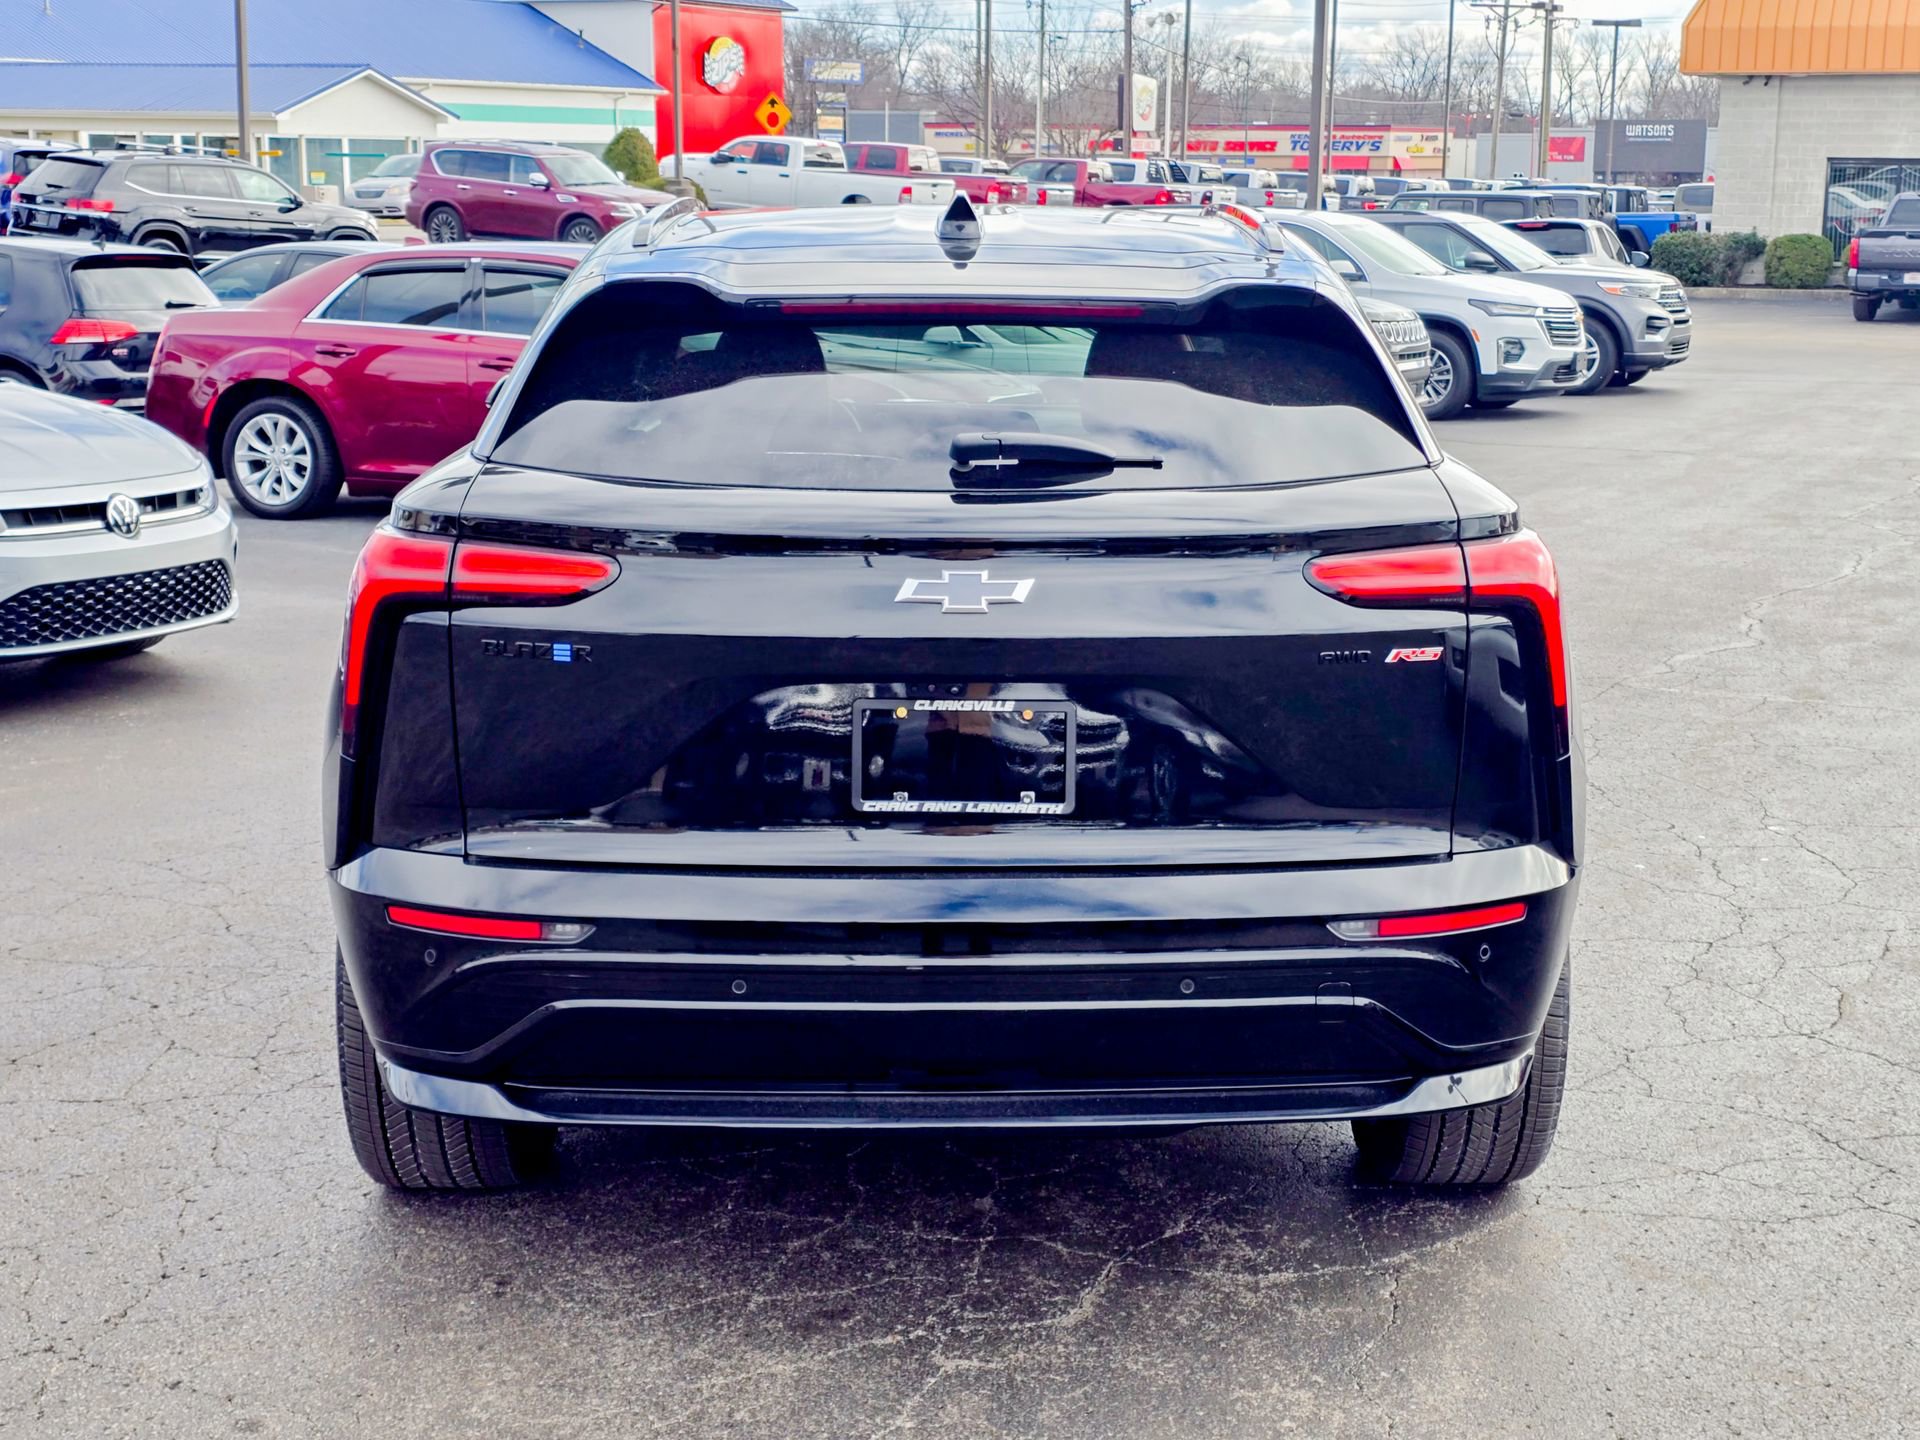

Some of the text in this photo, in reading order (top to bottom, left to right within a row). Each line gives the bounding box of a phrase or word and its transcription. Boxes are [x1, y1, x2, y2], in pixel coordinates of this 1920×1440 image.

[1626, 124, 1675, 136] WATSON'S
[1290, 140, 1383, 151] TOERY'S
[1384, 647, 1444, 663] RS
[913, 700, 1016, 712] CLARKSVILLE
[863, 801, 1064, 814] CRAIG AND LANDRETH
